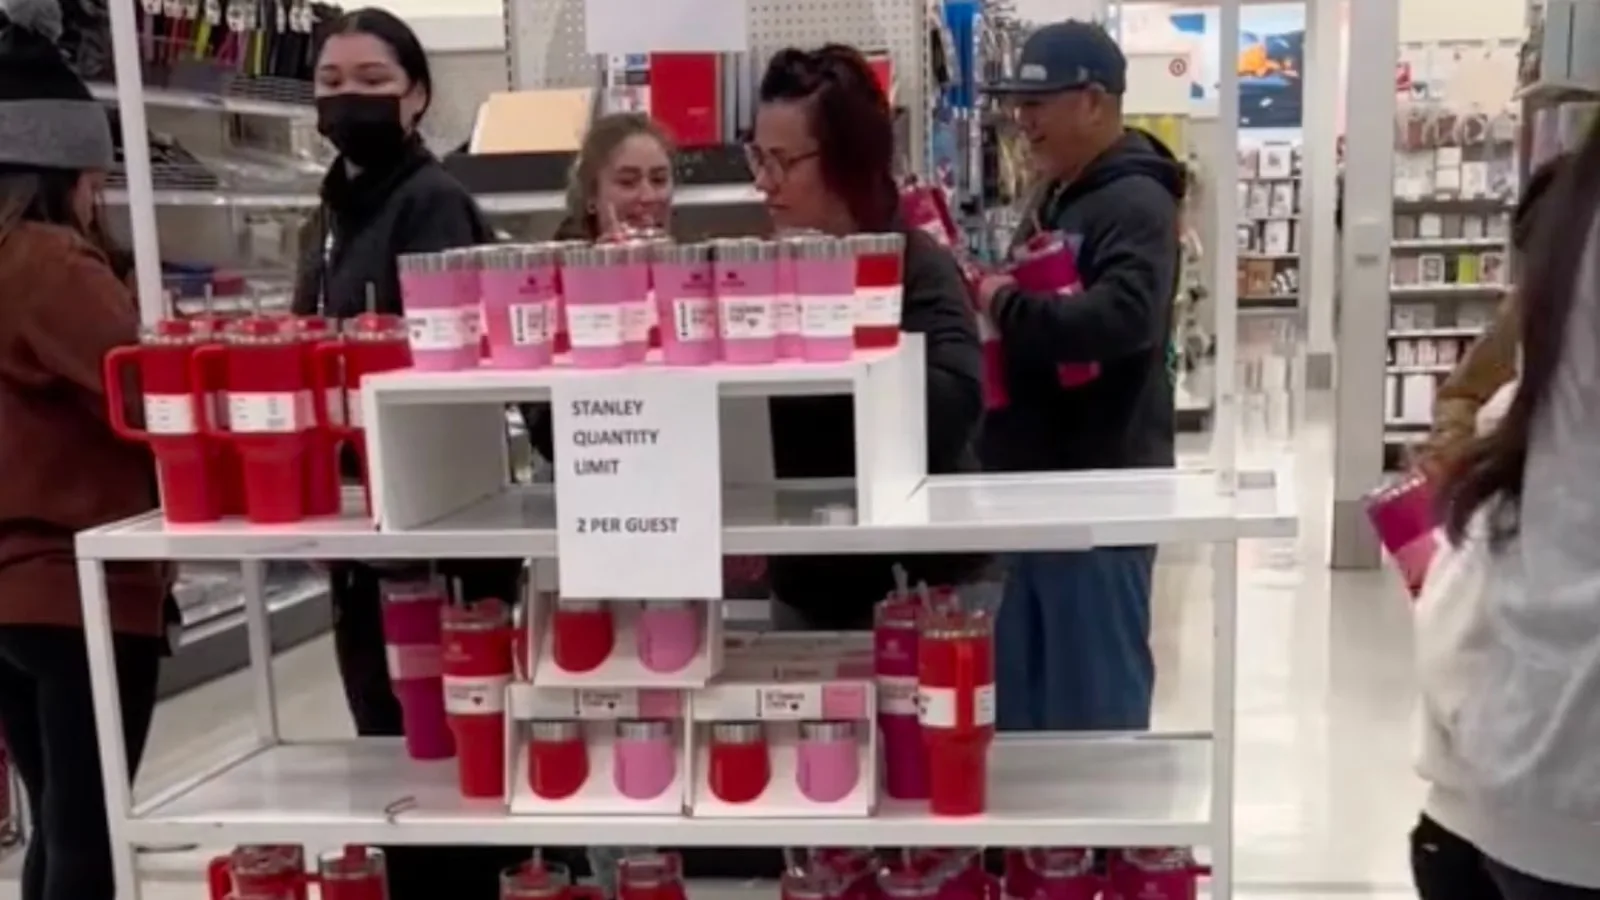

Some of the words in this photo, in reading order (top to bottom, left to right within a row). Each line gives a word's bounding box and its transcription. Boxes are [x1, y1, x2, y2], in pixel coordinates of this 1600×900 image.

[571, 400, 643, 416] STANLEY
[572, 430, 658, 446] QUANTITY
[574, 460, 619, 475] LIMIT
[576, 517, 587, 533] 2
[590, 517, 621, 533] PER
[625, 517, 677, 533] GUEST
